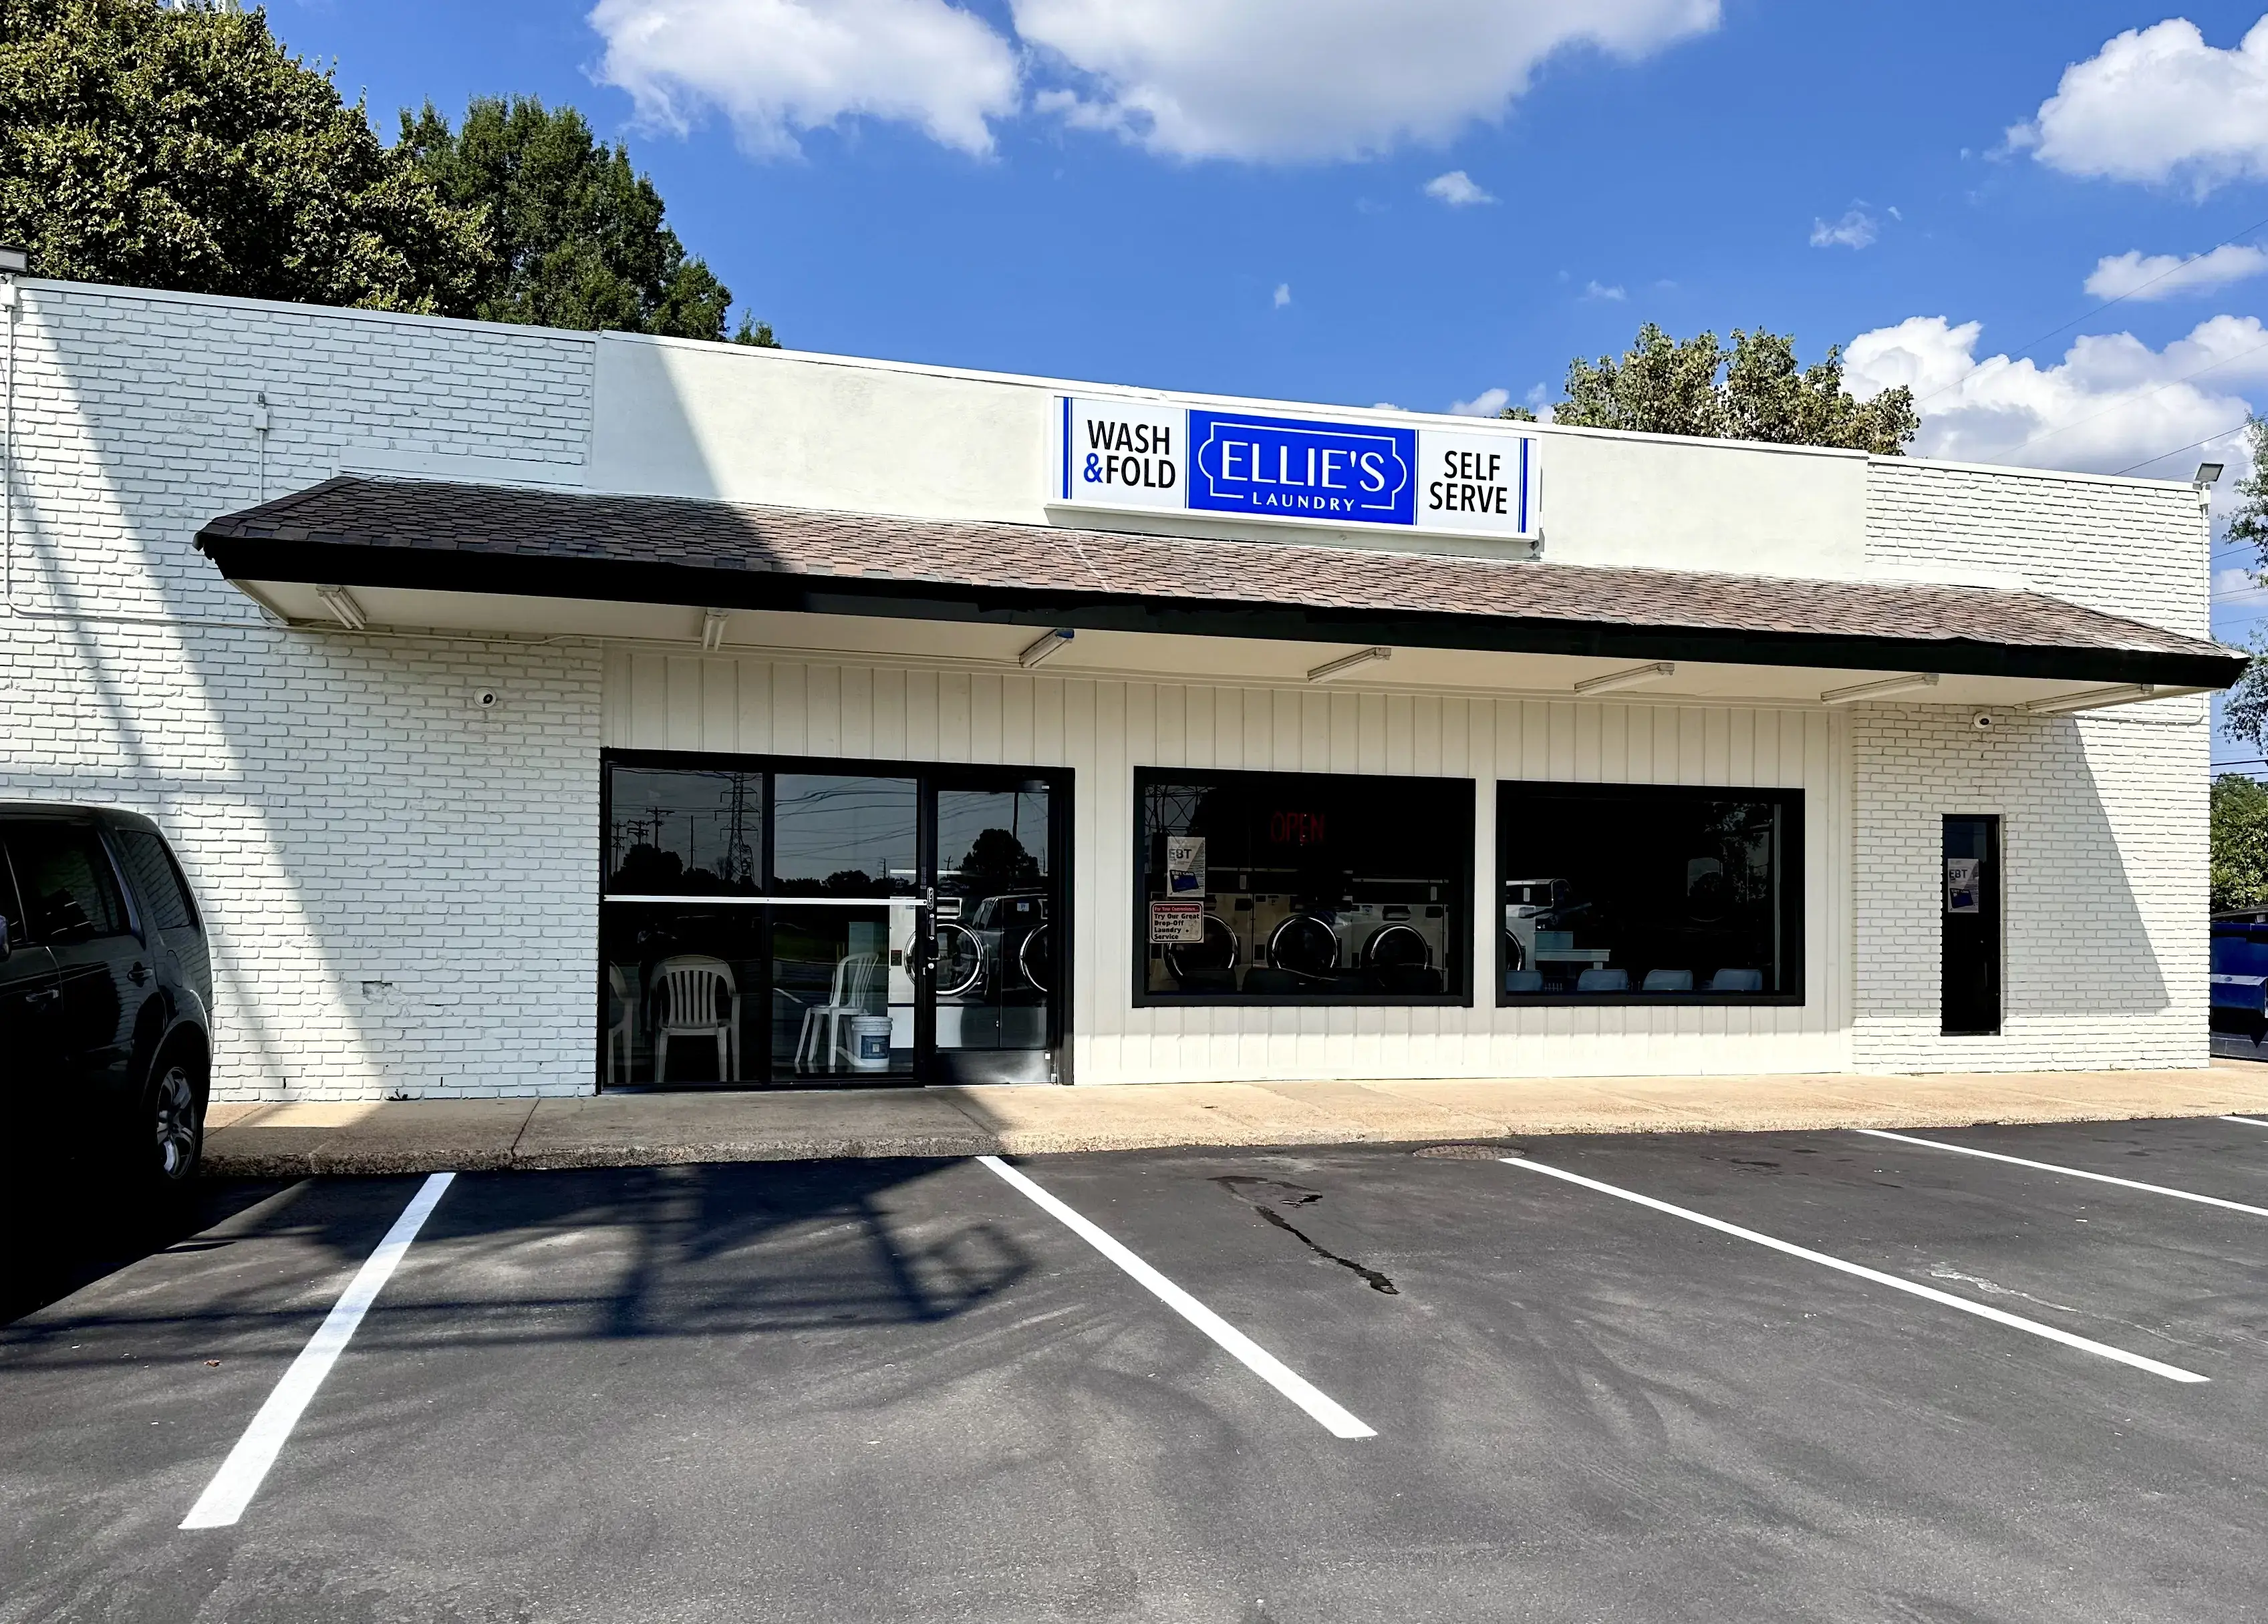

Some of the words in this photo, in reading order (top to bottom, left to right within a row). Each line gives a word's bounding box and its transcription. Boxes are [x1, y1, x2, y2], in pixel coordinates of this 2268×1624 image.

[1087, 420, 1169, 455] WASH
[1083, 452, 1176, 488] &FOLD
[1222, 440, 1385, 492] ELLIE'S
[1443, 450, 1501, 481] SELF
[1253, 492, 1355, 511] LAUNDRY
[1429, 482, 1508, 514] SERVE
[1270, 810, 1325, 842] OPEN
[1169, 848, 1192, 859] EBT
[1949, 869, 1968, 878] EBT
